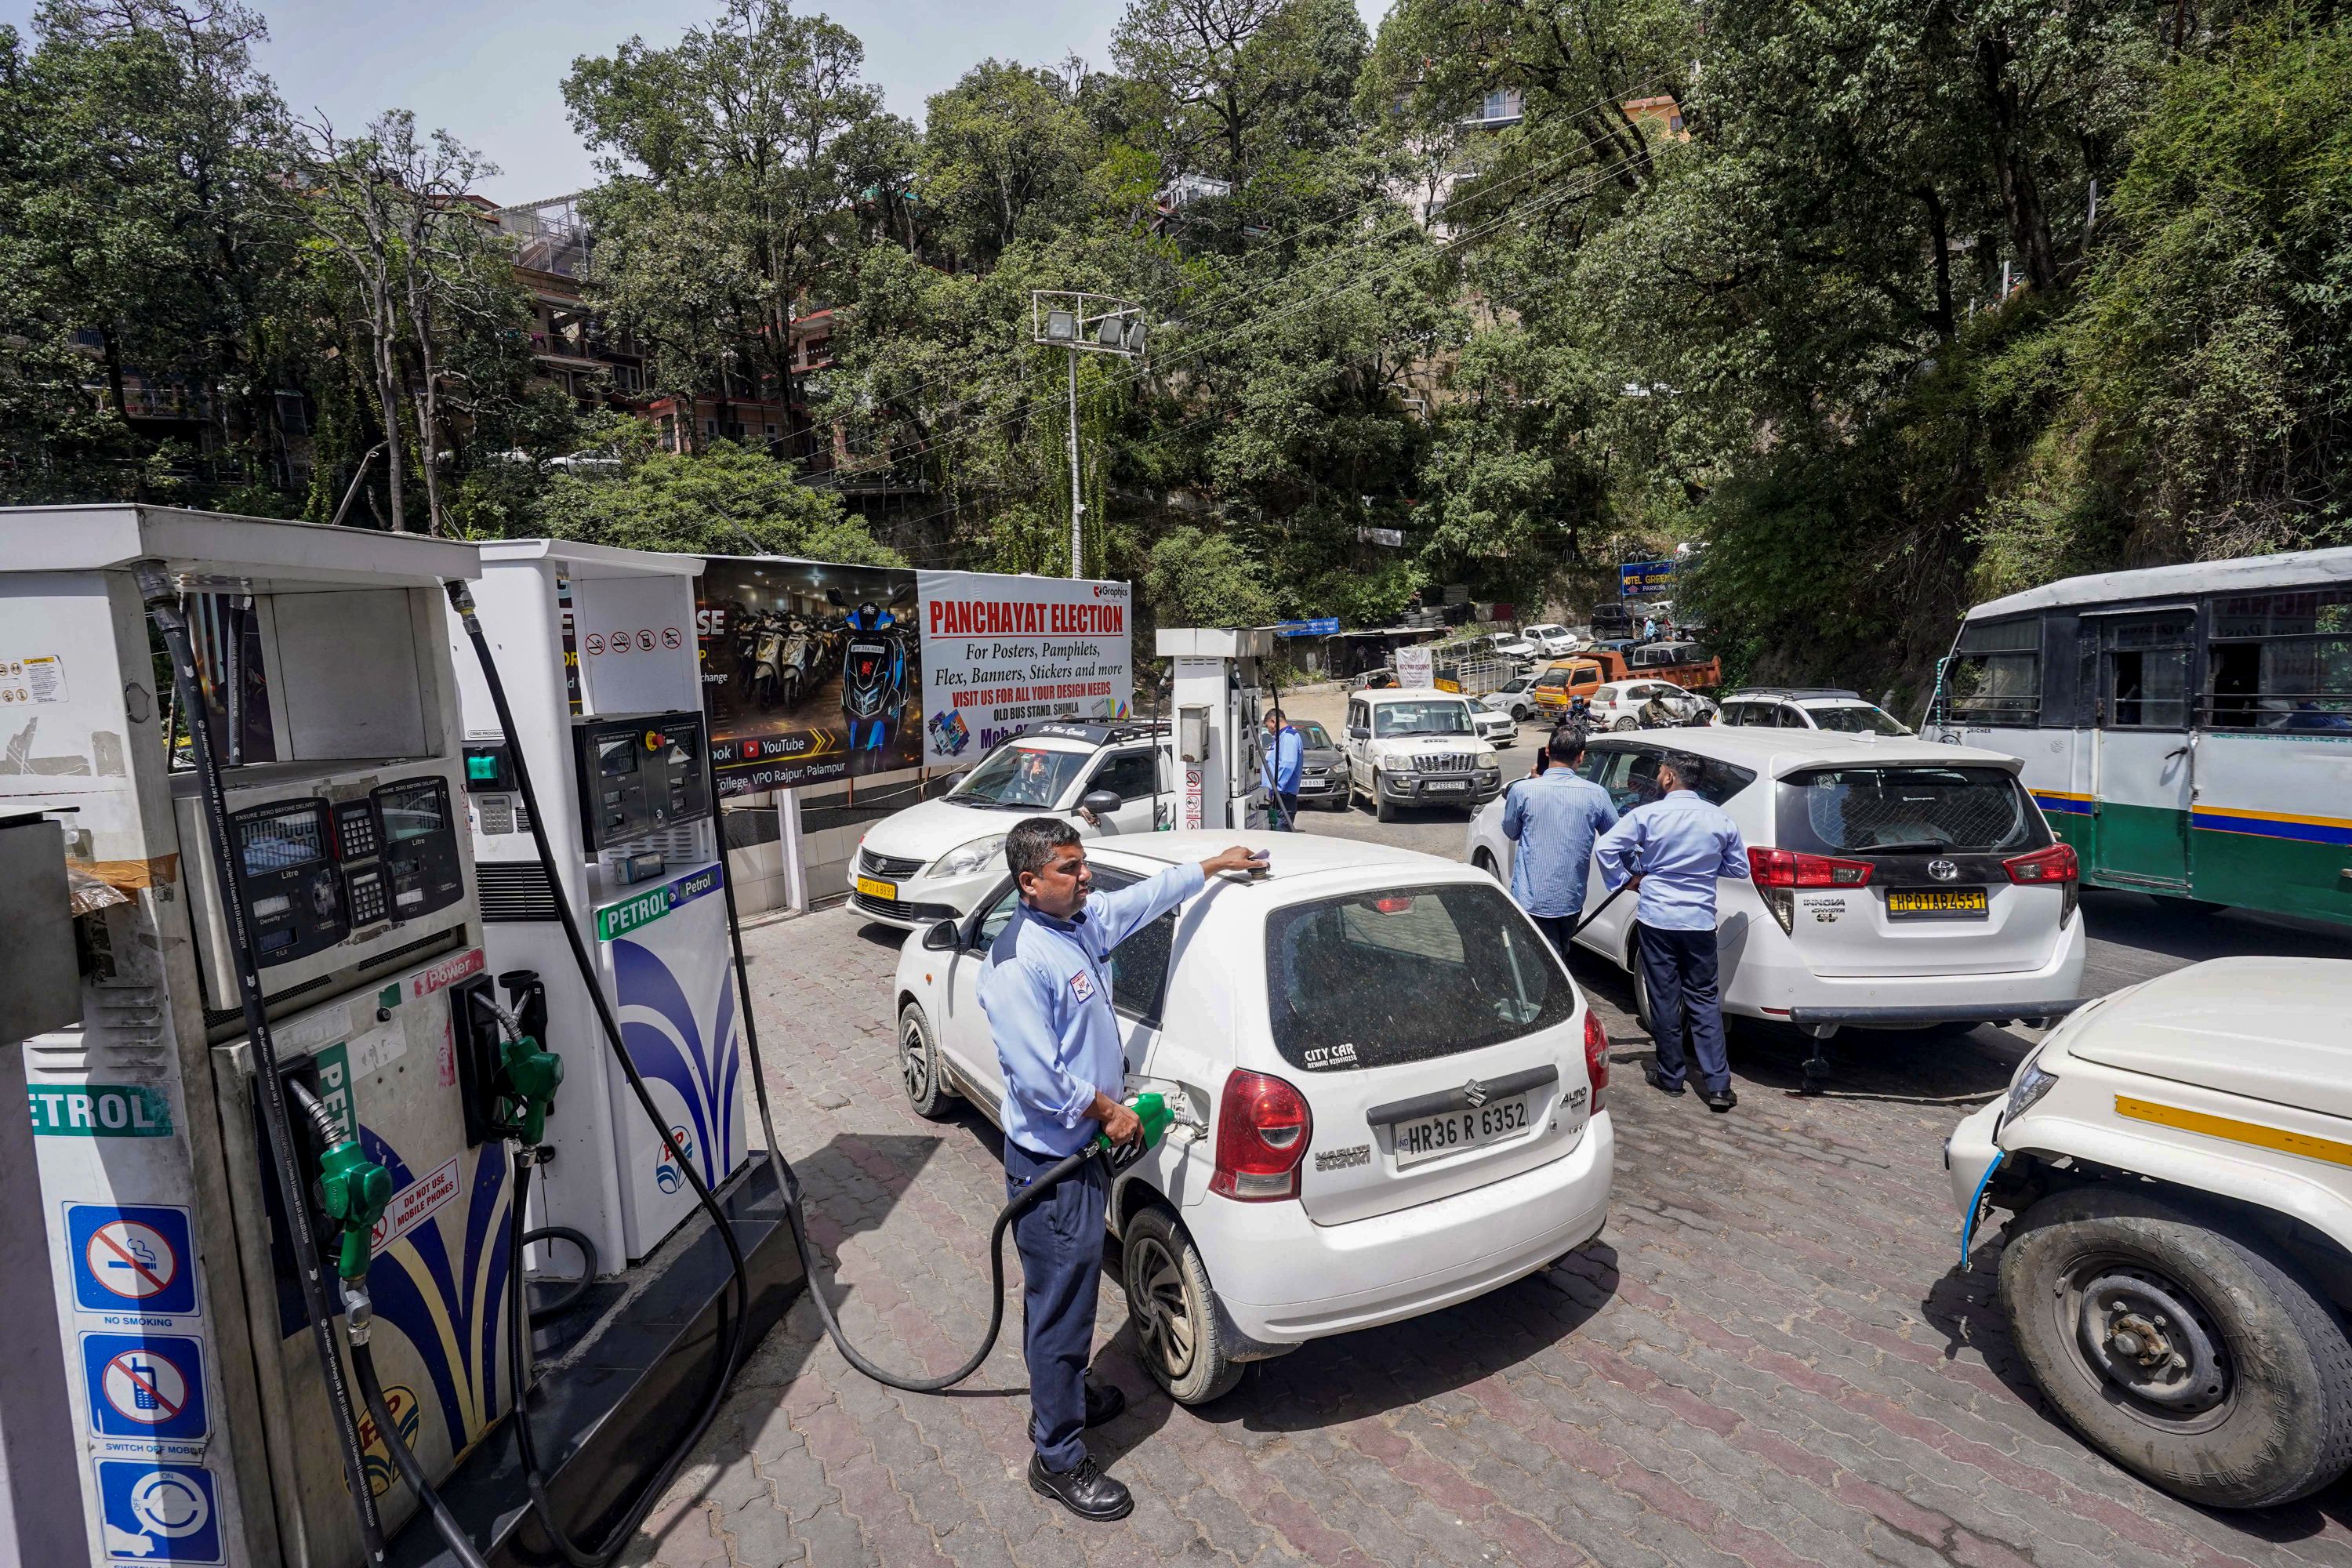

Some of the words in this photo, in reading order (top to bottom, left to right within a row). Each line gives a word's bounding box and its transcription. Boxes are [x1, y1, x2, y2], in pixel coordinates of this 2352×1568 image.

[1624, 576, 1642, 585] HOTEL
[1102, 586, 1127, 598] Graphics
[696, 610, 724, 635] SE
[930, 601, 1047, 633] PANCHAYAT
[1051, 604, 1123, 633] ELECTION
[966, 644, 988, 660] For
[993, 643, 1038, 659] Posters,
[1042, 641, 1100, 661] Pamphlets,
[701, 673, 728, 684] change
[935, 670, 966, 687] Flex,
[972, 667, 1025, 683] Banners,
[1030, 664, 1072, 681] Stickers
[1076, 662, 1096, 677] and
[1098, 665, 1123, 677] more
[952, 691, 979, 707] VISIT
[981, 690, 994, 706] US
[996, 688, 1013, 704] FOR
[1014, 687, 1030, 702] ALL
[1032, 685, 1057, 701] YOUR
[1058, 684, 1086, 699] DESIGN
[1088, 682, 1110, 696] NEEDS
[994, 709, 1009, 721] OLD
[1011, 707, 1025, 720] BUS
[1027, 705, 1051, 718] STAND,
[1054, 702, 1079, 715] SHIMLA
[763, 739, 804, 753] YouTube
[753, 771, 771, 785] VPO
[775, 768, 804, 784] Rajpur,
[808, 762, 845, 777] Palampur
[235, 812, 257, 821] ENSURE
[274, 804, 295, 813] BEFORE
[281, 870, 299, 880] Litre
[685, 875, 710, 895] Petrol
[1897, 892, 1984, 911] HP01AB4551
[260, 915, 281, 925] Density
[608, 892, 668, 935] PETROL
[429, 960, 470, 987] Power
[1305, 1047, 1329, 1062] CITY
[1331, 1043, 1355, 1057] CAR
[1308, 1060, 1328, 1069] REWARI
[319, 1062, 352, 1142] PET
[1559, 1087, 1587, 1109] ALTO
[28, 1093, 155, 1129] TROL
[1398, 1138, 1408, 1148] IND
[1409, 1120, 1457, 1155] HR36
[1464, 1115, 1474, 1140] R
[1483, 1102, 1526, 1135] 6352
[1316, 1145, 1370, 1160] MARUTI
[1316, 1152, 1370, 1171] SUZUKI
[404, 1195, 415, 1208] DO
[416, 1185, 431, 1200] NOT
[431, 1173, 445, 1189] USE
[397, 1203, 425, 1228] MOBILE
[426, 1181, 454, 1207] PHONES
[105, 1316, 120, 1325] NO
[123, 1317, 172, 1327] SMOKING
[106, 1443, 143, 1452] SWITCH
[146, 1444, 165, 1454] OFF
